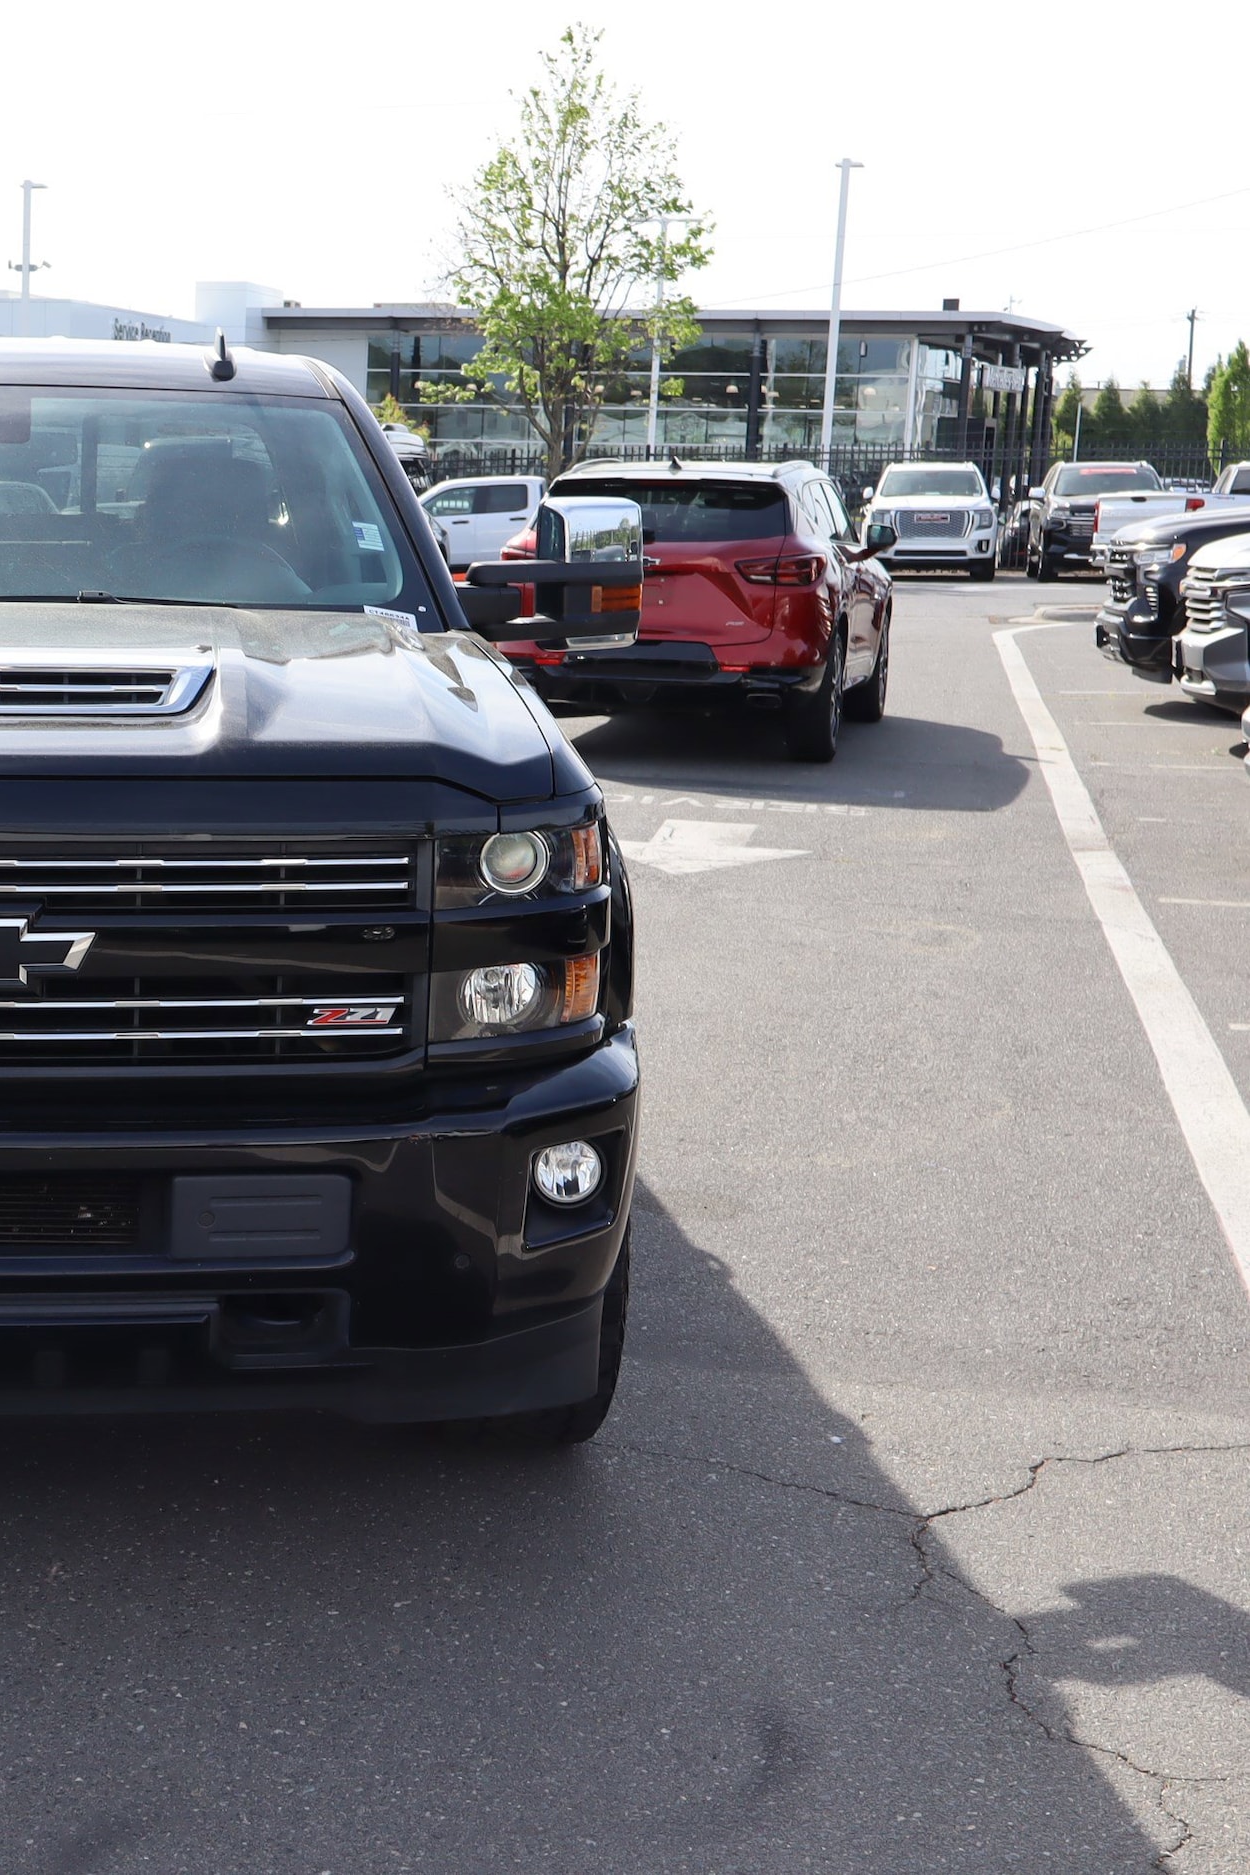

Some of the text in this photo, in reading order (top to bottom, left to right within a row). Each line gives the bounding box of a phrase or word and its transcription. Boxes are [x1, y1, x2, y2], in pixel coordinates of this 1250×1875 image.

[114, 318, 138, 340] Service
[605, 793, 870, 817] SERVIC
[306, 1007, 396, 1025] Z71
